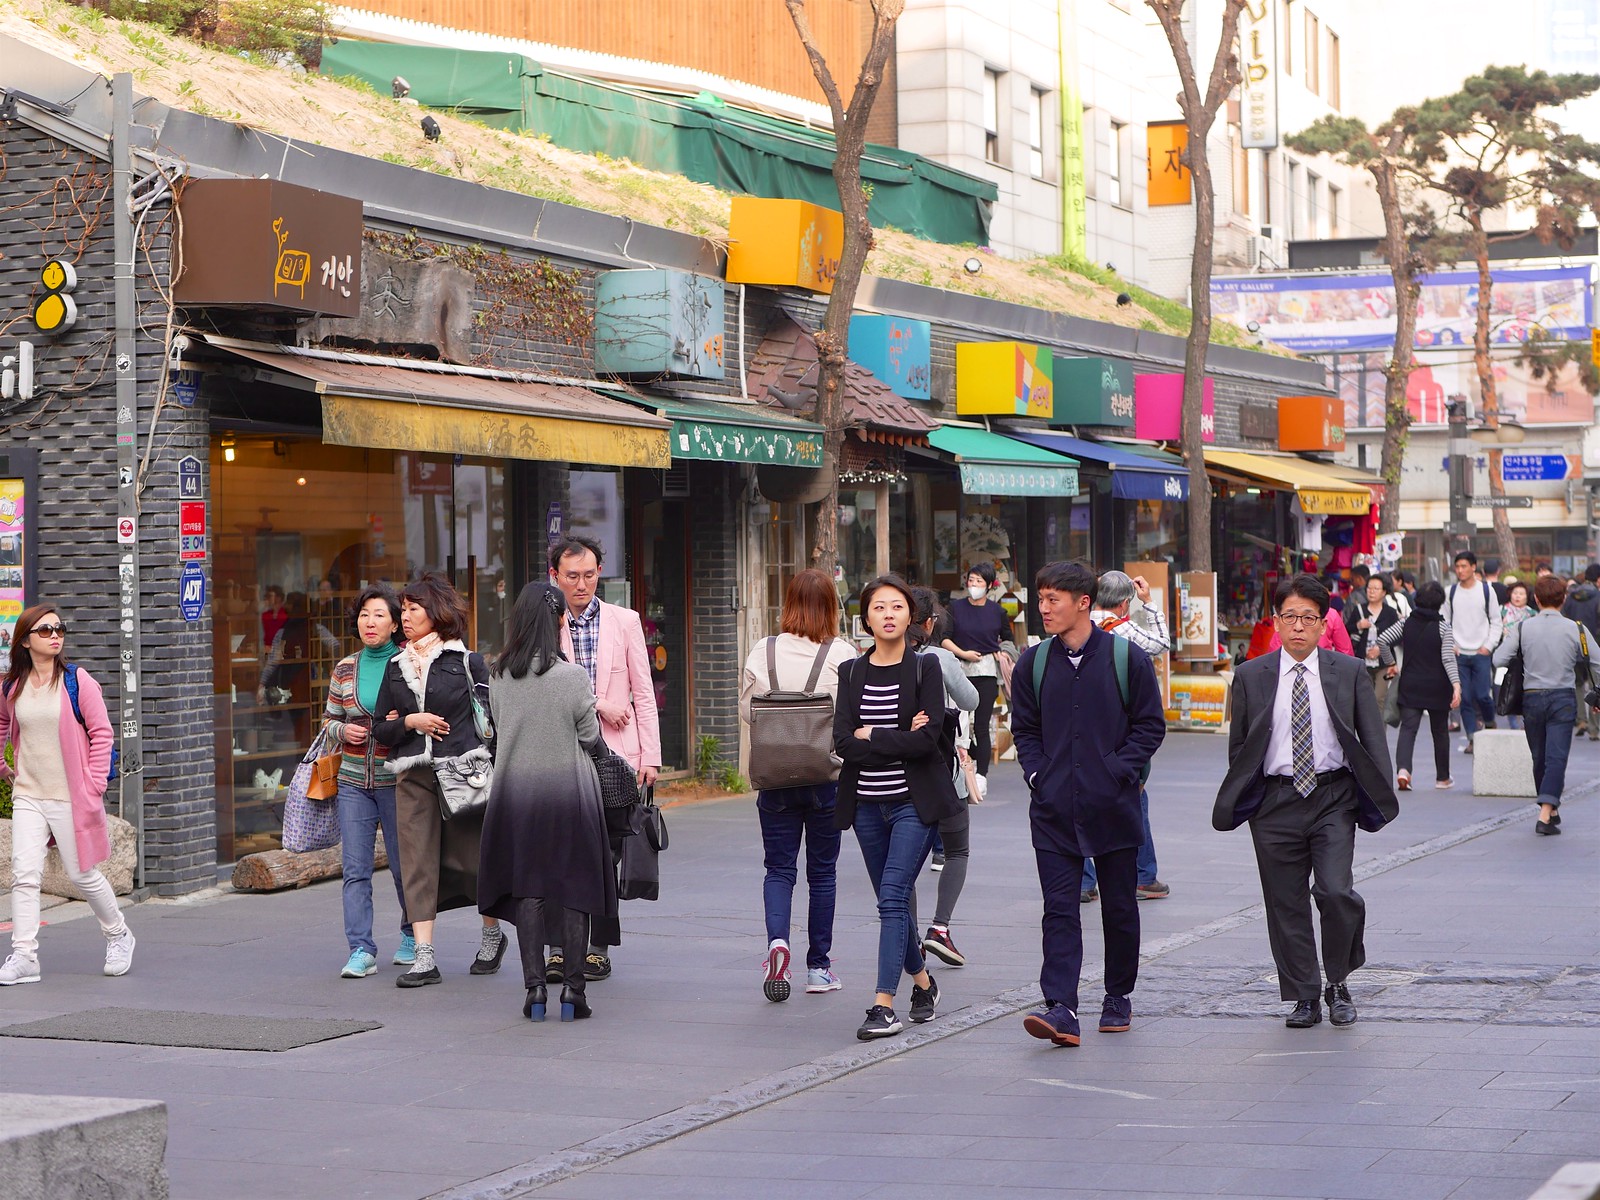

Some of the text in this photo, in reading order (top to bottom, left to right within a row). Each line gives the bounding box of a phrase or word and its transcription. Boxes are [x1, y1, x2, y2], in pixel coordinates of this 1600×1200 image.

[320, 254, 353, 298] 거안
[1223, 283, 1239, 291] ART
[1240, 283, 1275, 291] GALLERY
[185, 477, 197, 493] 44
[549, 516, 562, 535] ADT
[183, 579, 202, 602] ADT
